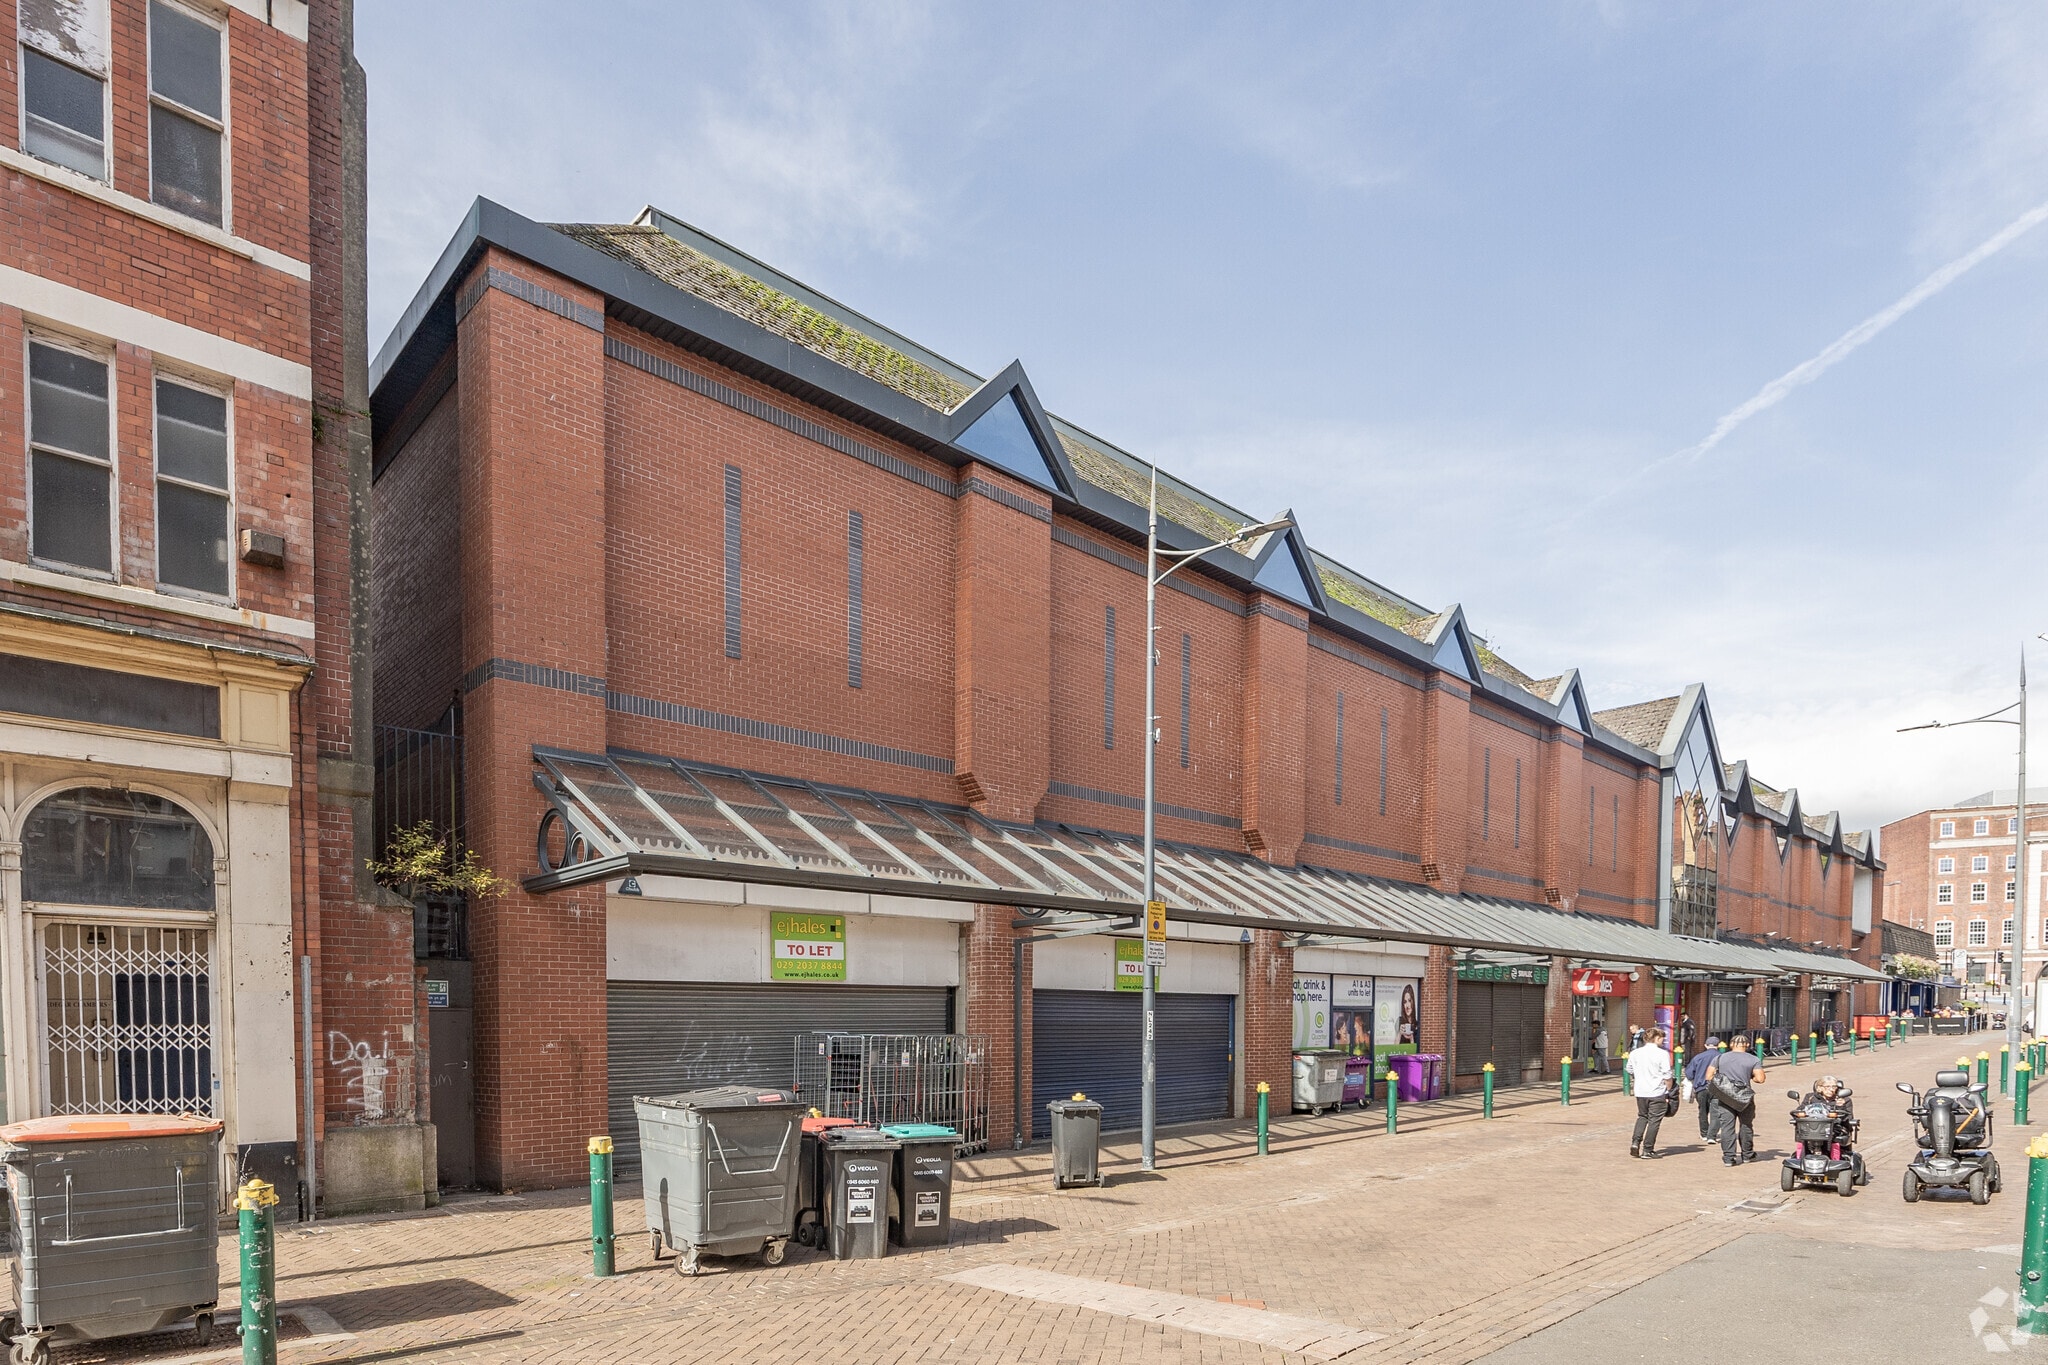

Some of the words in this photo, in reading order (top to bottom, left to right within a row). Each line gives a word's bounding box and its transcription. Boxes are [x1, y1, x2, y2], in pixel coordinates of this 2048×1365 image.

[777, 917, 826, 937] ejhales
[787, 944, 805, 956] TO
[809, 945, 833, 957] LET
[1120, 944, 1144, 958] ejhale
[777, 961, 794, 969] 029
[797, 961, 818, 969] 2037
[821, 962, 843, 970] 8844
[1125, 964, 1136, 973] TO
[785, 971, 839, 979] www.ejhales.co.uk
[1293, 979, 1301, 990] at,
[1303, 979, 1320, 990] drink
[1321, 980, 1326, 990] &
[1599, 975, 1613, 993] kes
[1347, 988, 1358, 996] units
